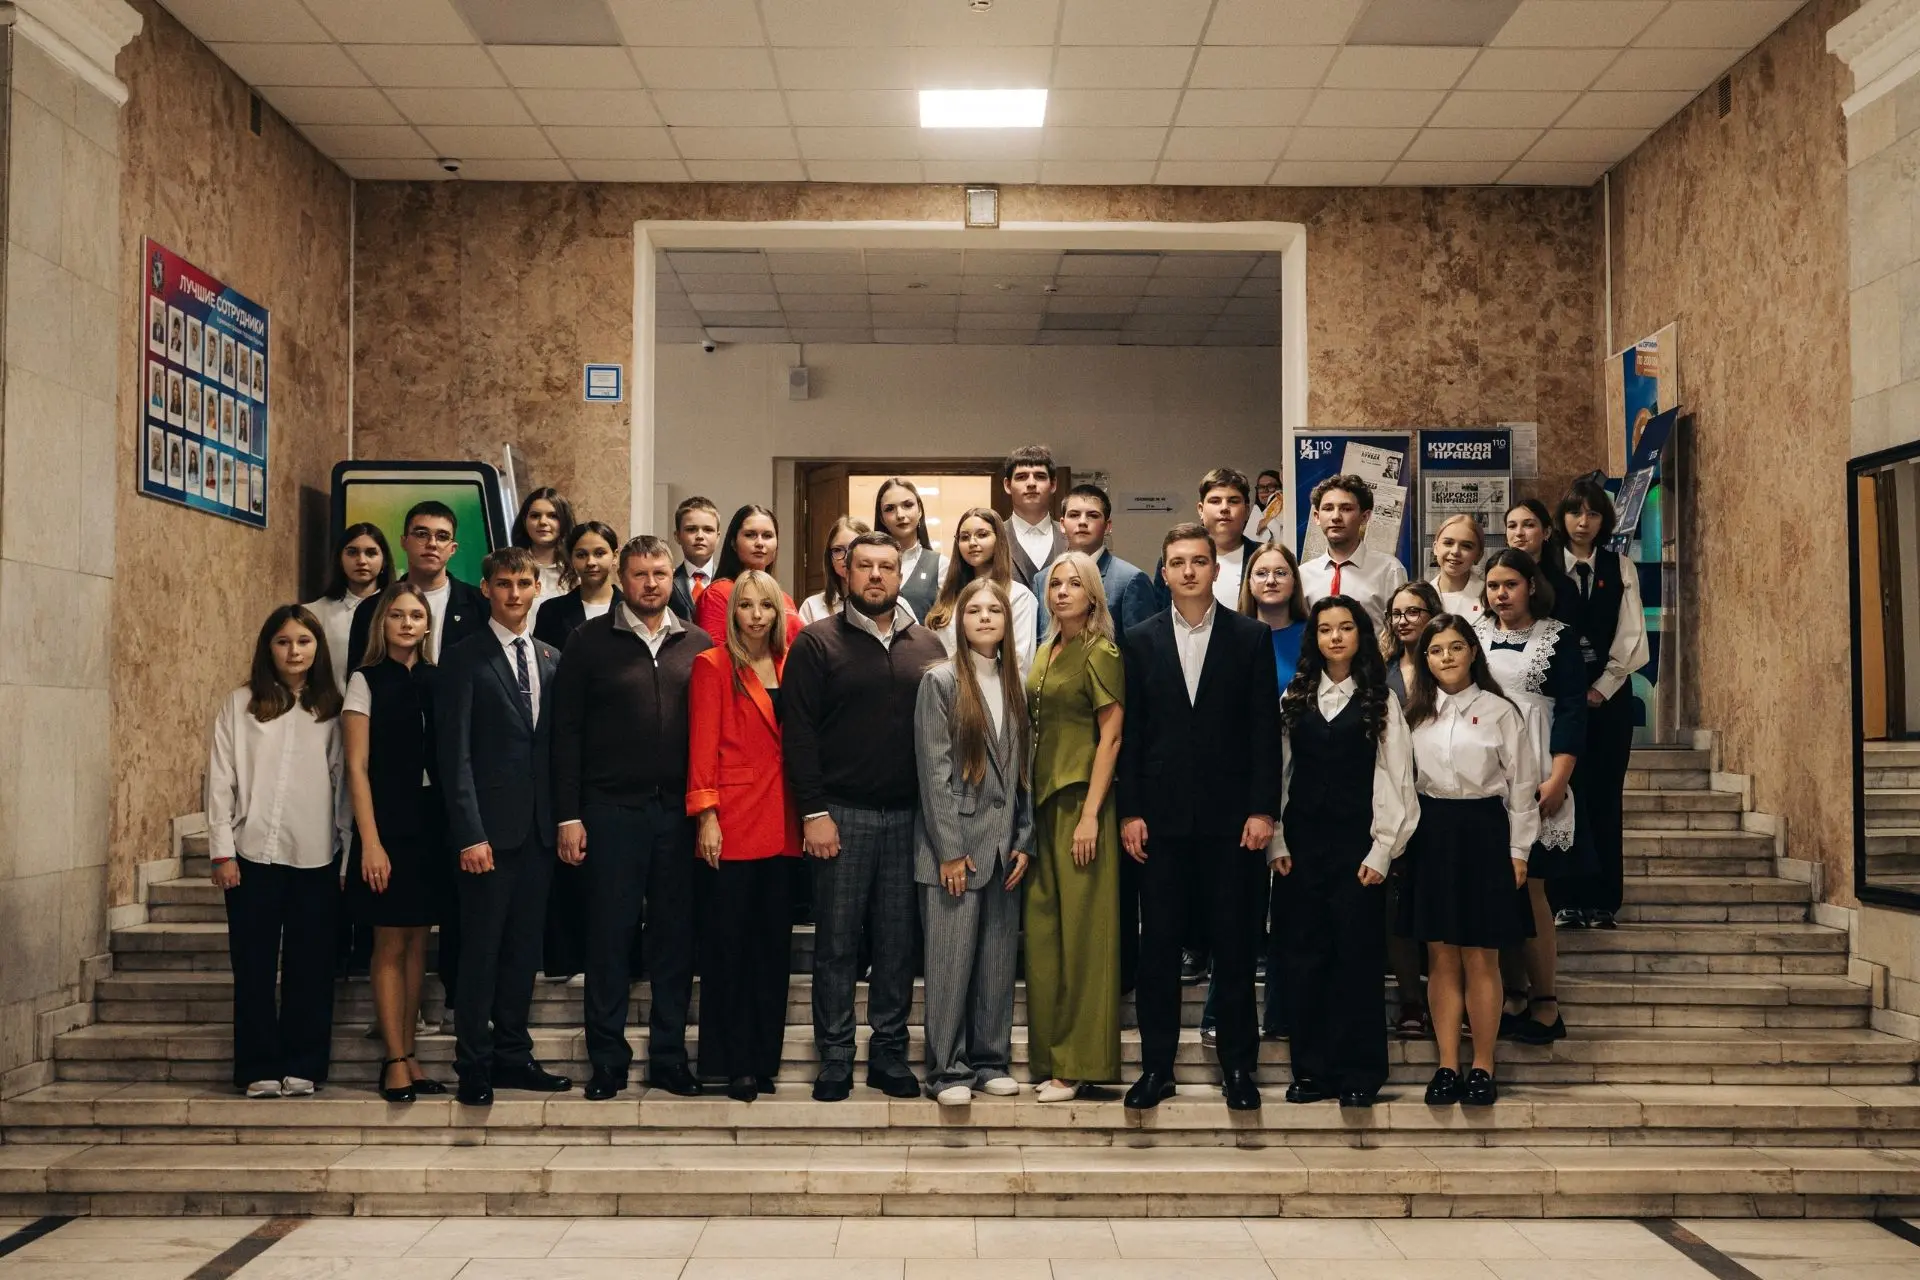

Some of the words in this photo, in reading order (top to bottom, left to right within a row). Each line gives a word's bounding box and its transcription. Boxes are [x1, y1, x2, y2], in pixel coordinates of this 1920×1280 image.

[180, 275, 215, 309] ЛУЧШИЕ
[216, 296, 265, 336] СОТРУДНИКИ
[1316, 441, 1332, 450] 110
[1428, 442, 1491, 451] КУРСКАЯ
[1492, 439, 1506, 447] 110
[1434, 451, 1491, 460] ПРАВДА
